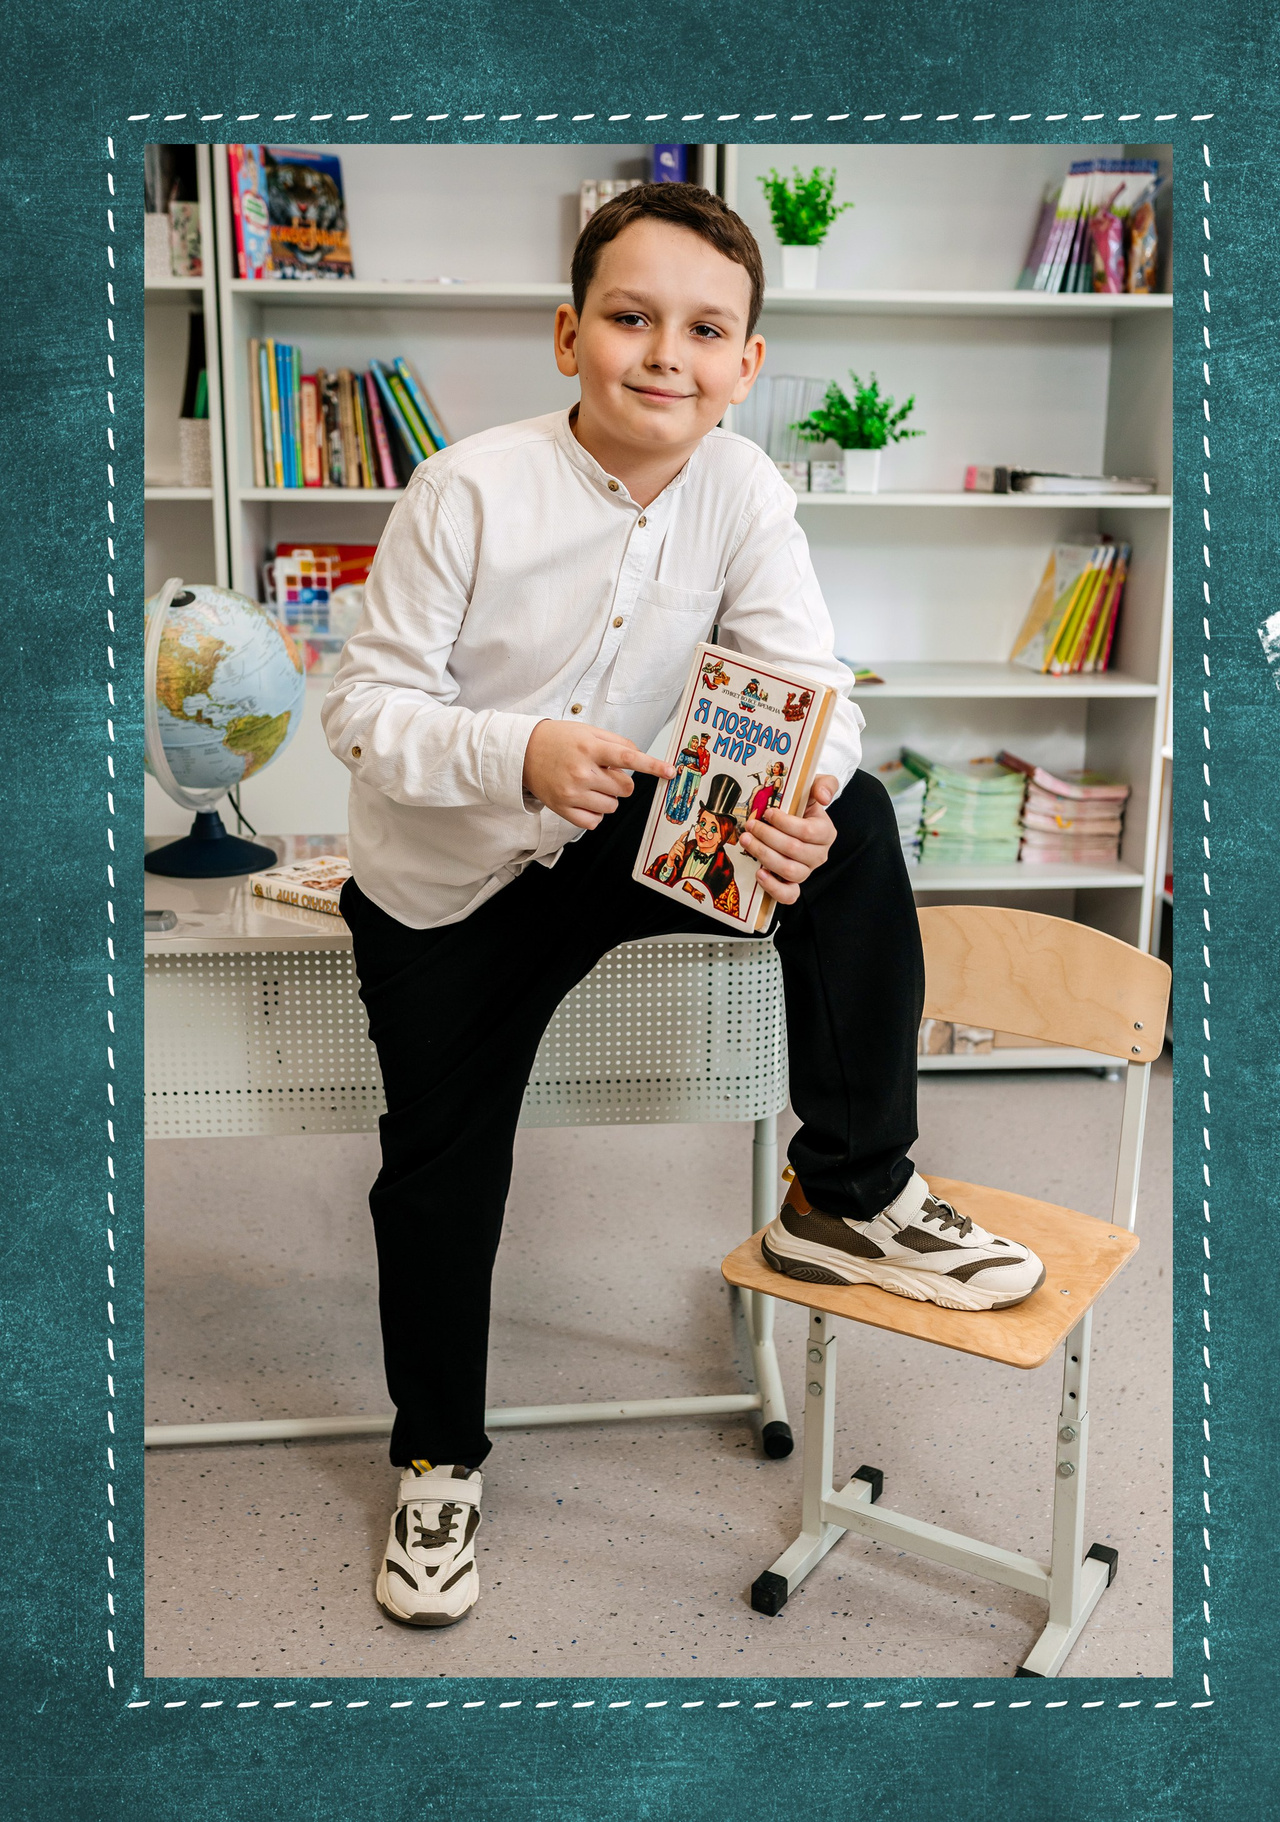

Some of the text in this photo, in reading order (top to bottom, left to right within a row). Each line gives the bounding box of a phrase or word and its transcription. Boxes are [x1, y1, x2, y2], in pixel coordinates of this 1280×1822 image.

[721, 688, 741, 699] ЭТИКЕТ
[757, 702, 781, 714] ВРЕМЕНА
[694, 698, 791, 755] Я ПОЗНАЮ
[713, 732, 757, 766] МИР
[301, 894, 343, 917] ОЗНАЮ
